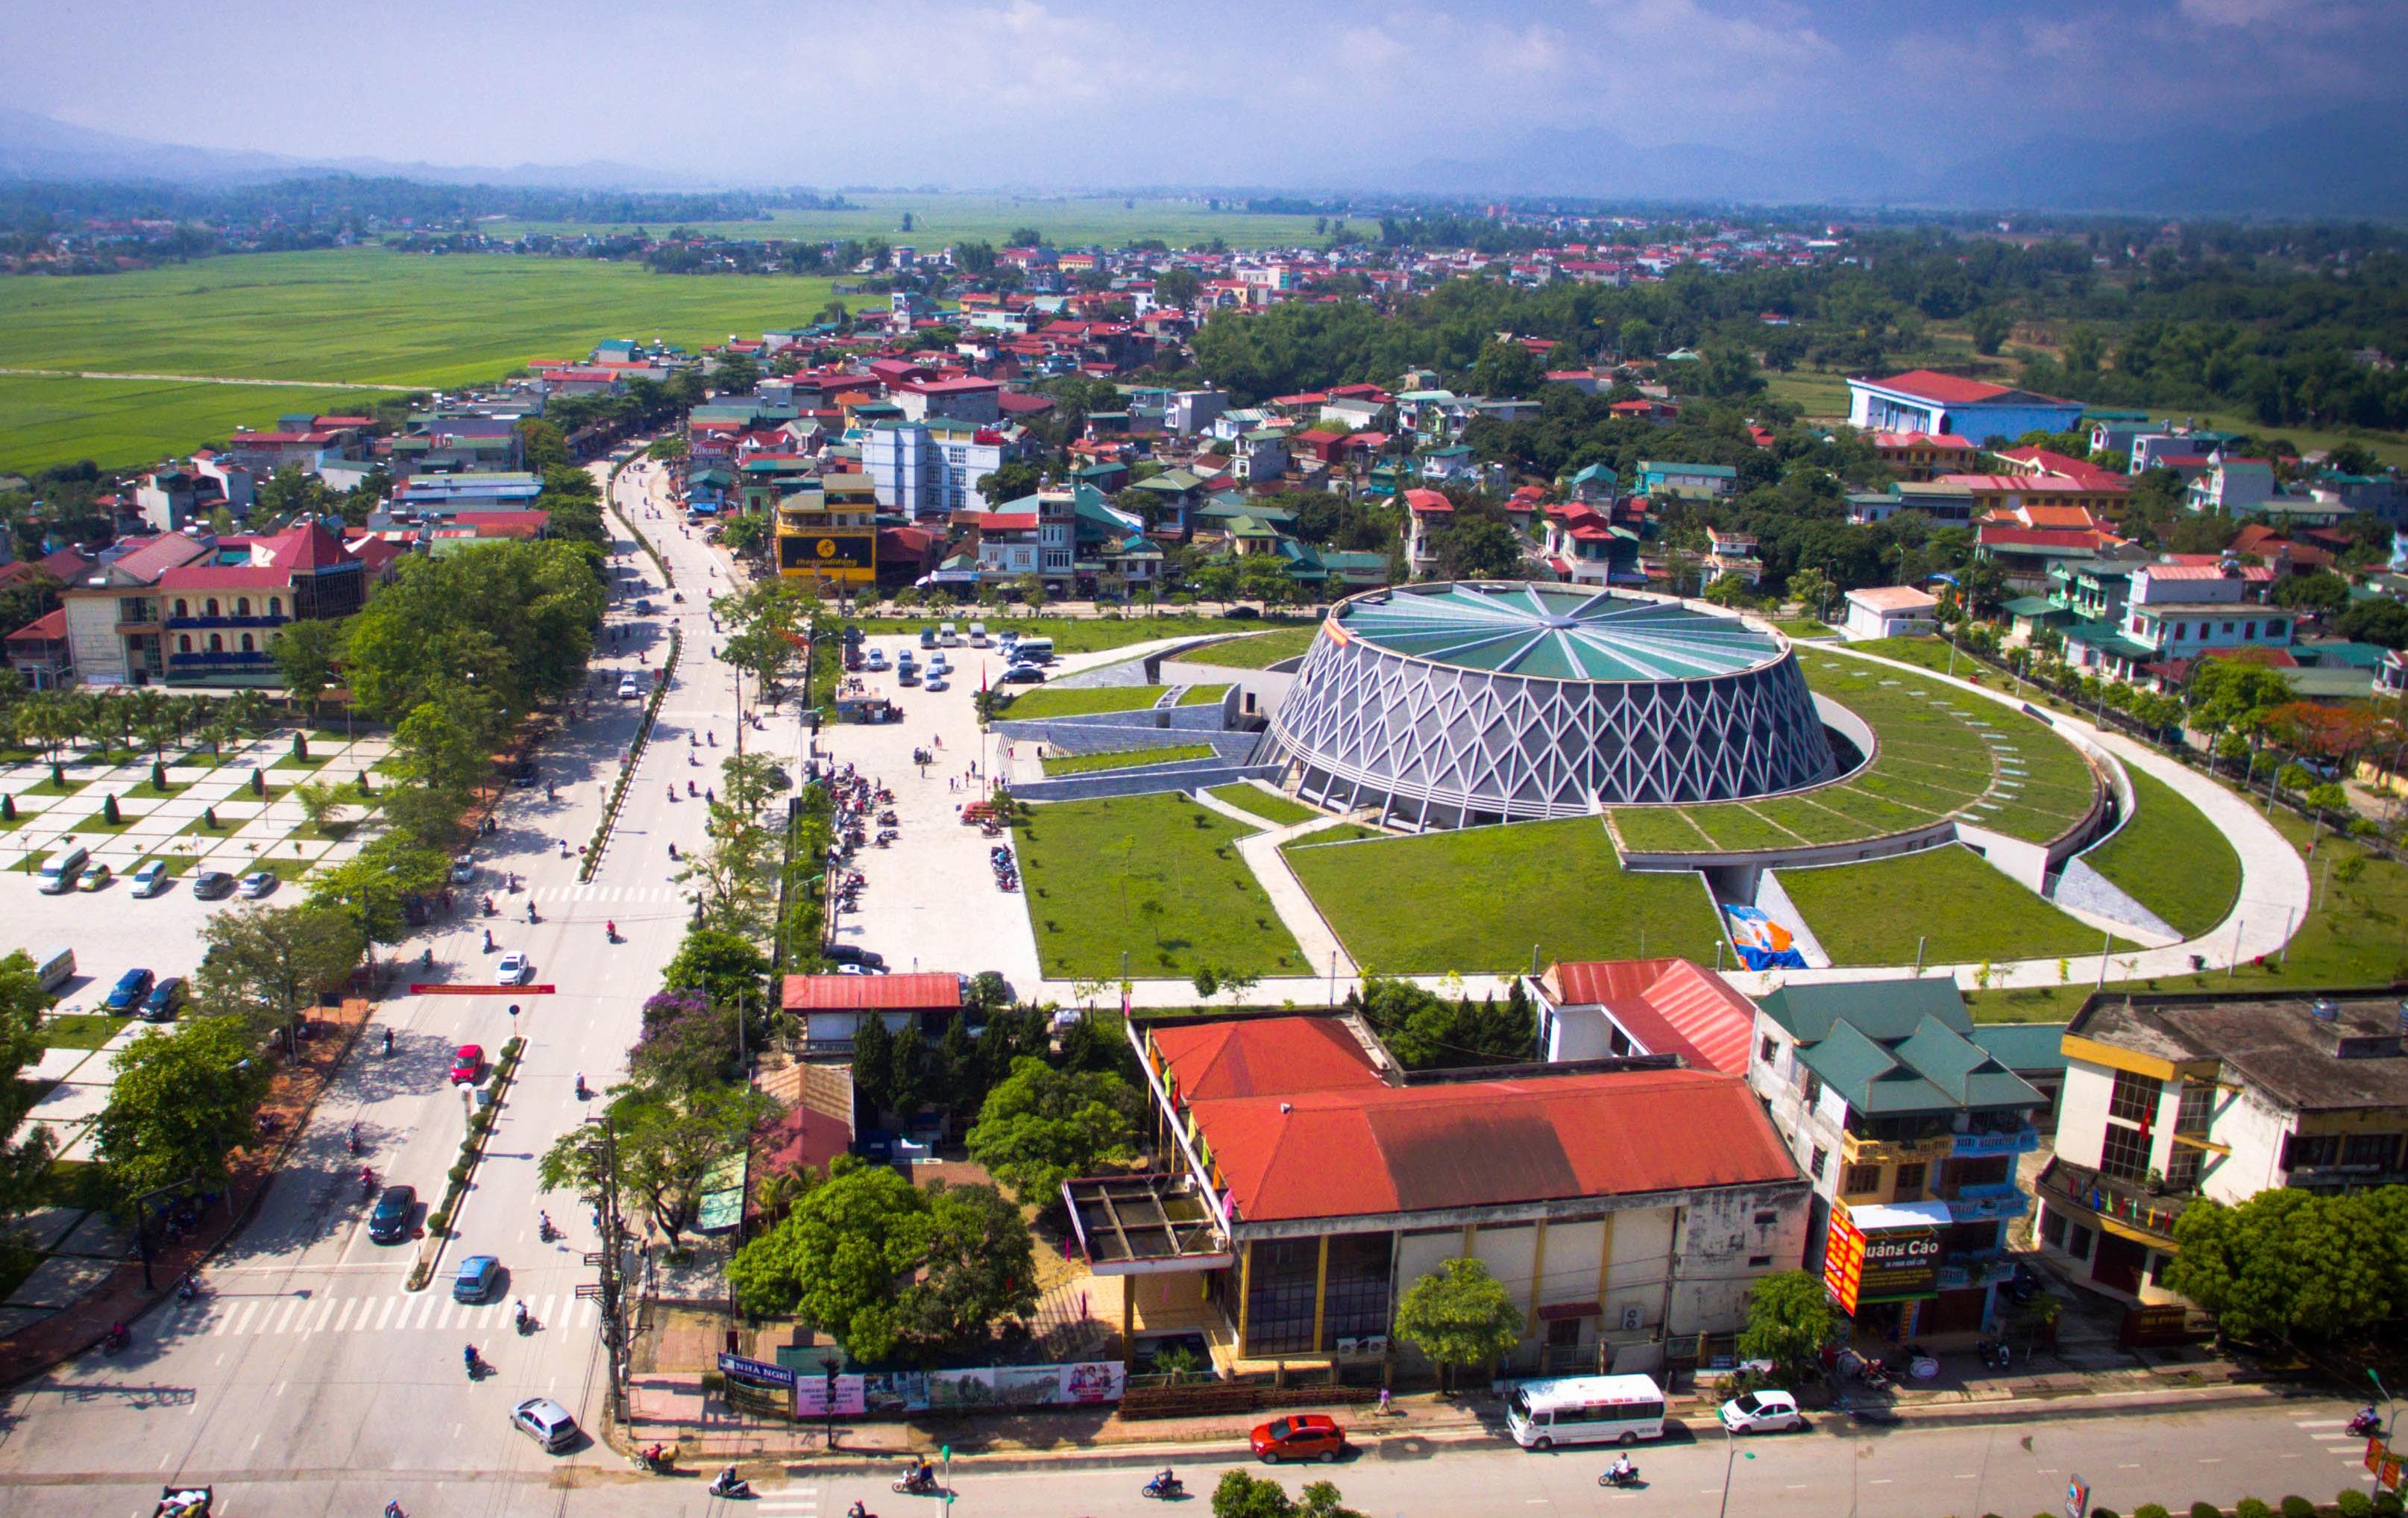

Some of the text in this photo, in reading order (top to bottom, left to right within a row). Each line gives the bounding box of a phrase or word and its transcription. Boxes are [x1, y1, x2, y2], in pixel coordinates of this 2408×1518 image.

[691, 443, 722, 455] Zikon
[1863, 1238, 1939, 1258] uảng Cáo
